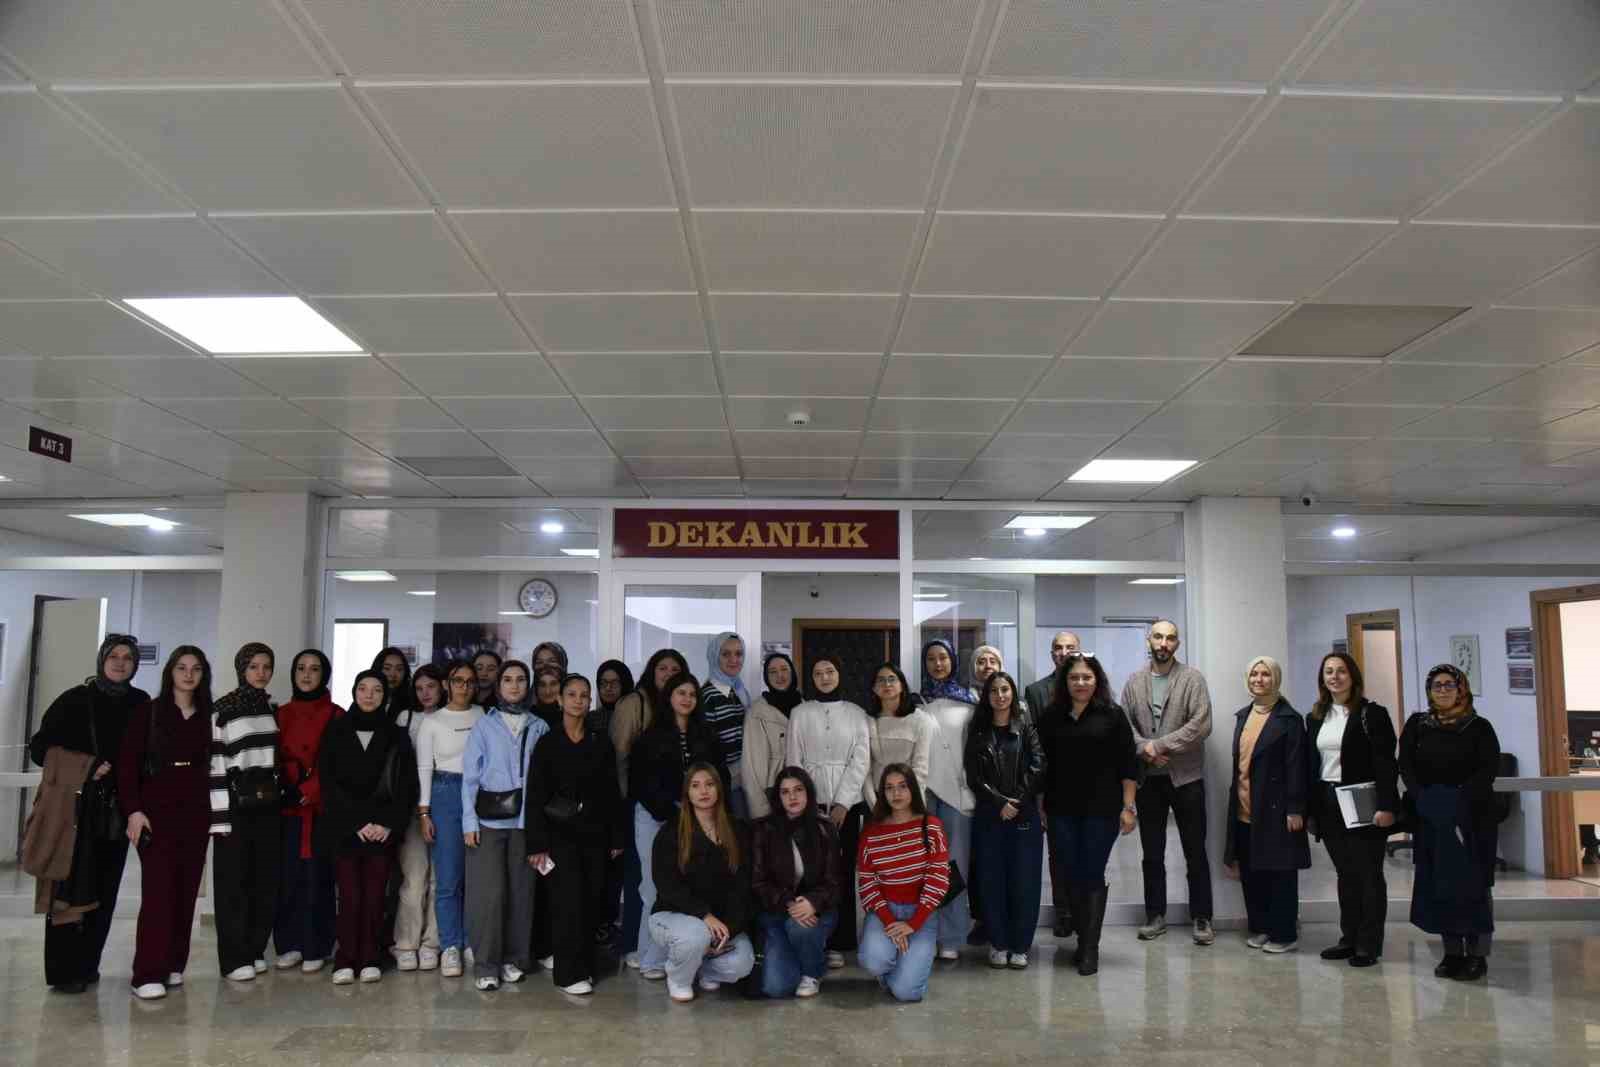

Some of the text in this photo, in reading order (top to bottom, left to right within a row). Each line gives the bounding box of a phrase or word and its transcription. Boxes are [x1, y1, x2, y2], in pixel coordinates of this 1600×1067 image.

[40, 436, 65, 455] KAT 3
[647, 521, 869, 548] DEKANLIK
